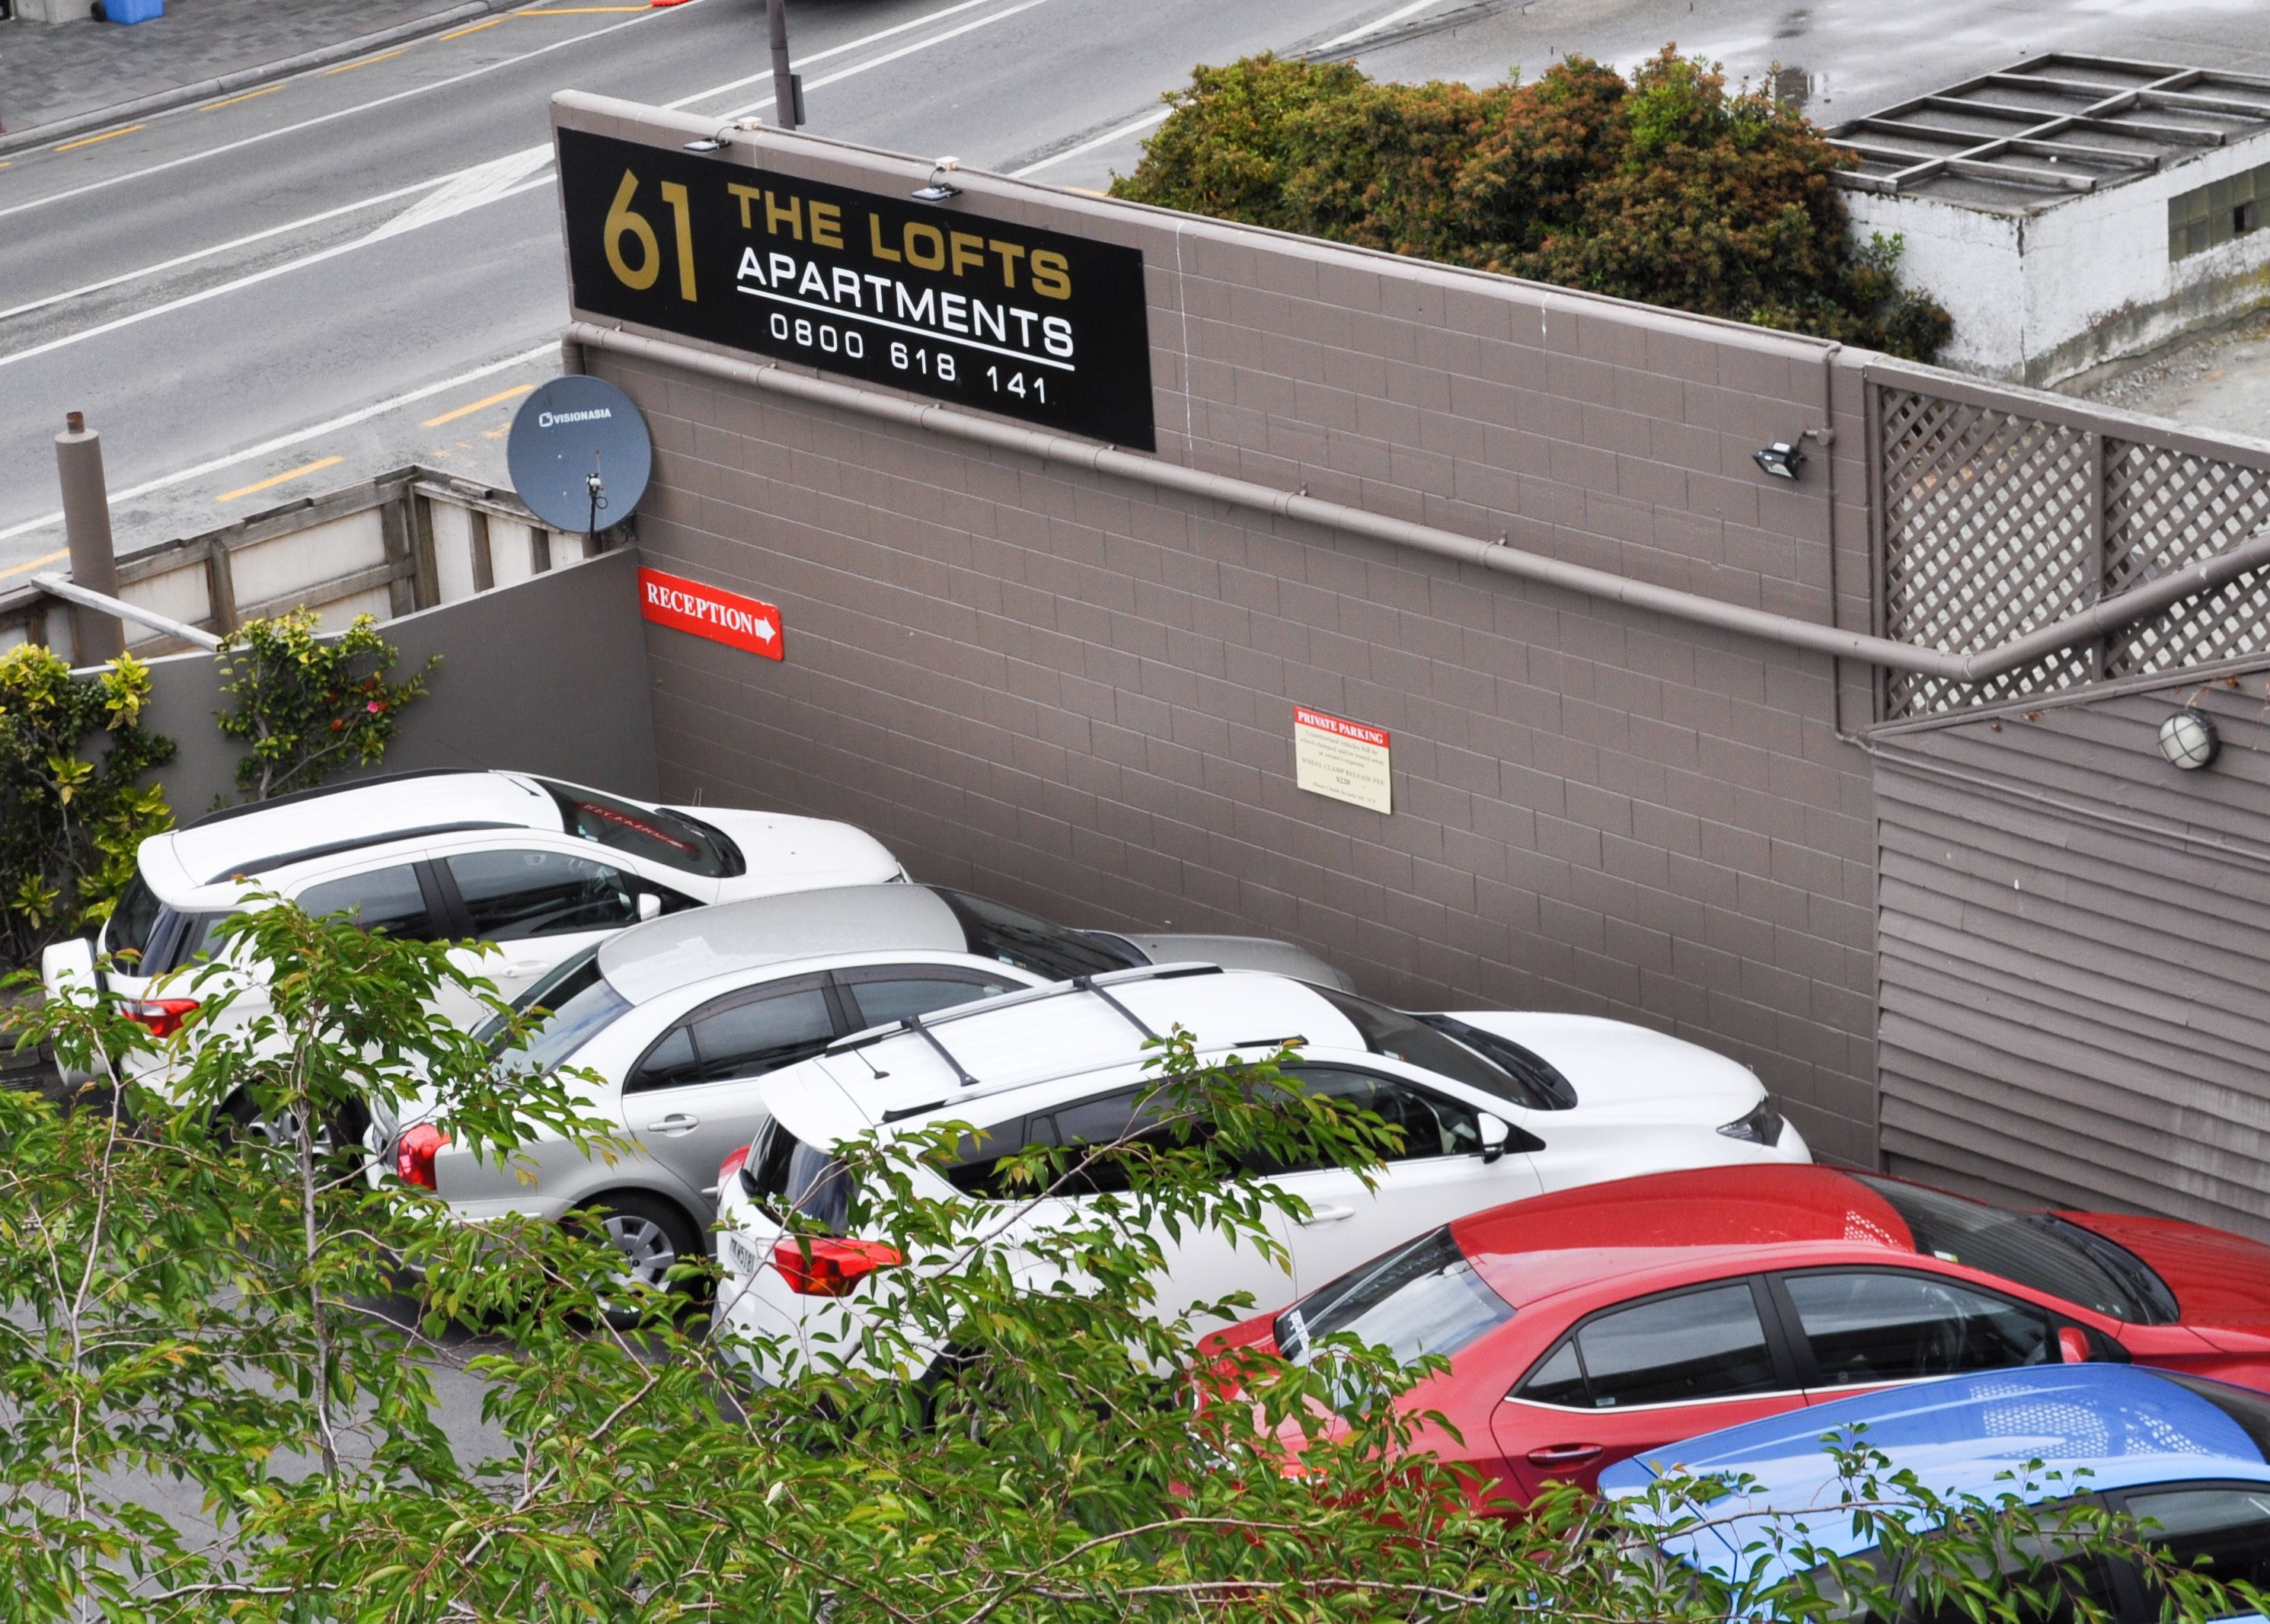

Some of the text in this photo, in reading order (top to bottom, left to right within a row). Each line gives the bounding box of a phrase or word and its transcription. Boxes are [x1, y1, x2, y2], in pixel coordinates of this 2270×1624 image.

[604, 168, 698, 303] 61
[727, 182, 1071, 300] THE LOFTS
[736, 247, 1074, 359] APARTMENTS
[770, 313, 1047, 404] 0800 618 141
[554, 408, 611, 424] VISIONASIA
[646, 582, 753, 635] RECEPTION
[1298, 710, 1382, 744] PRIVATE PARKING
[1323, 764, 1344, 774] CLAMP
[1346, 770, 1371, 782] RELEASE
